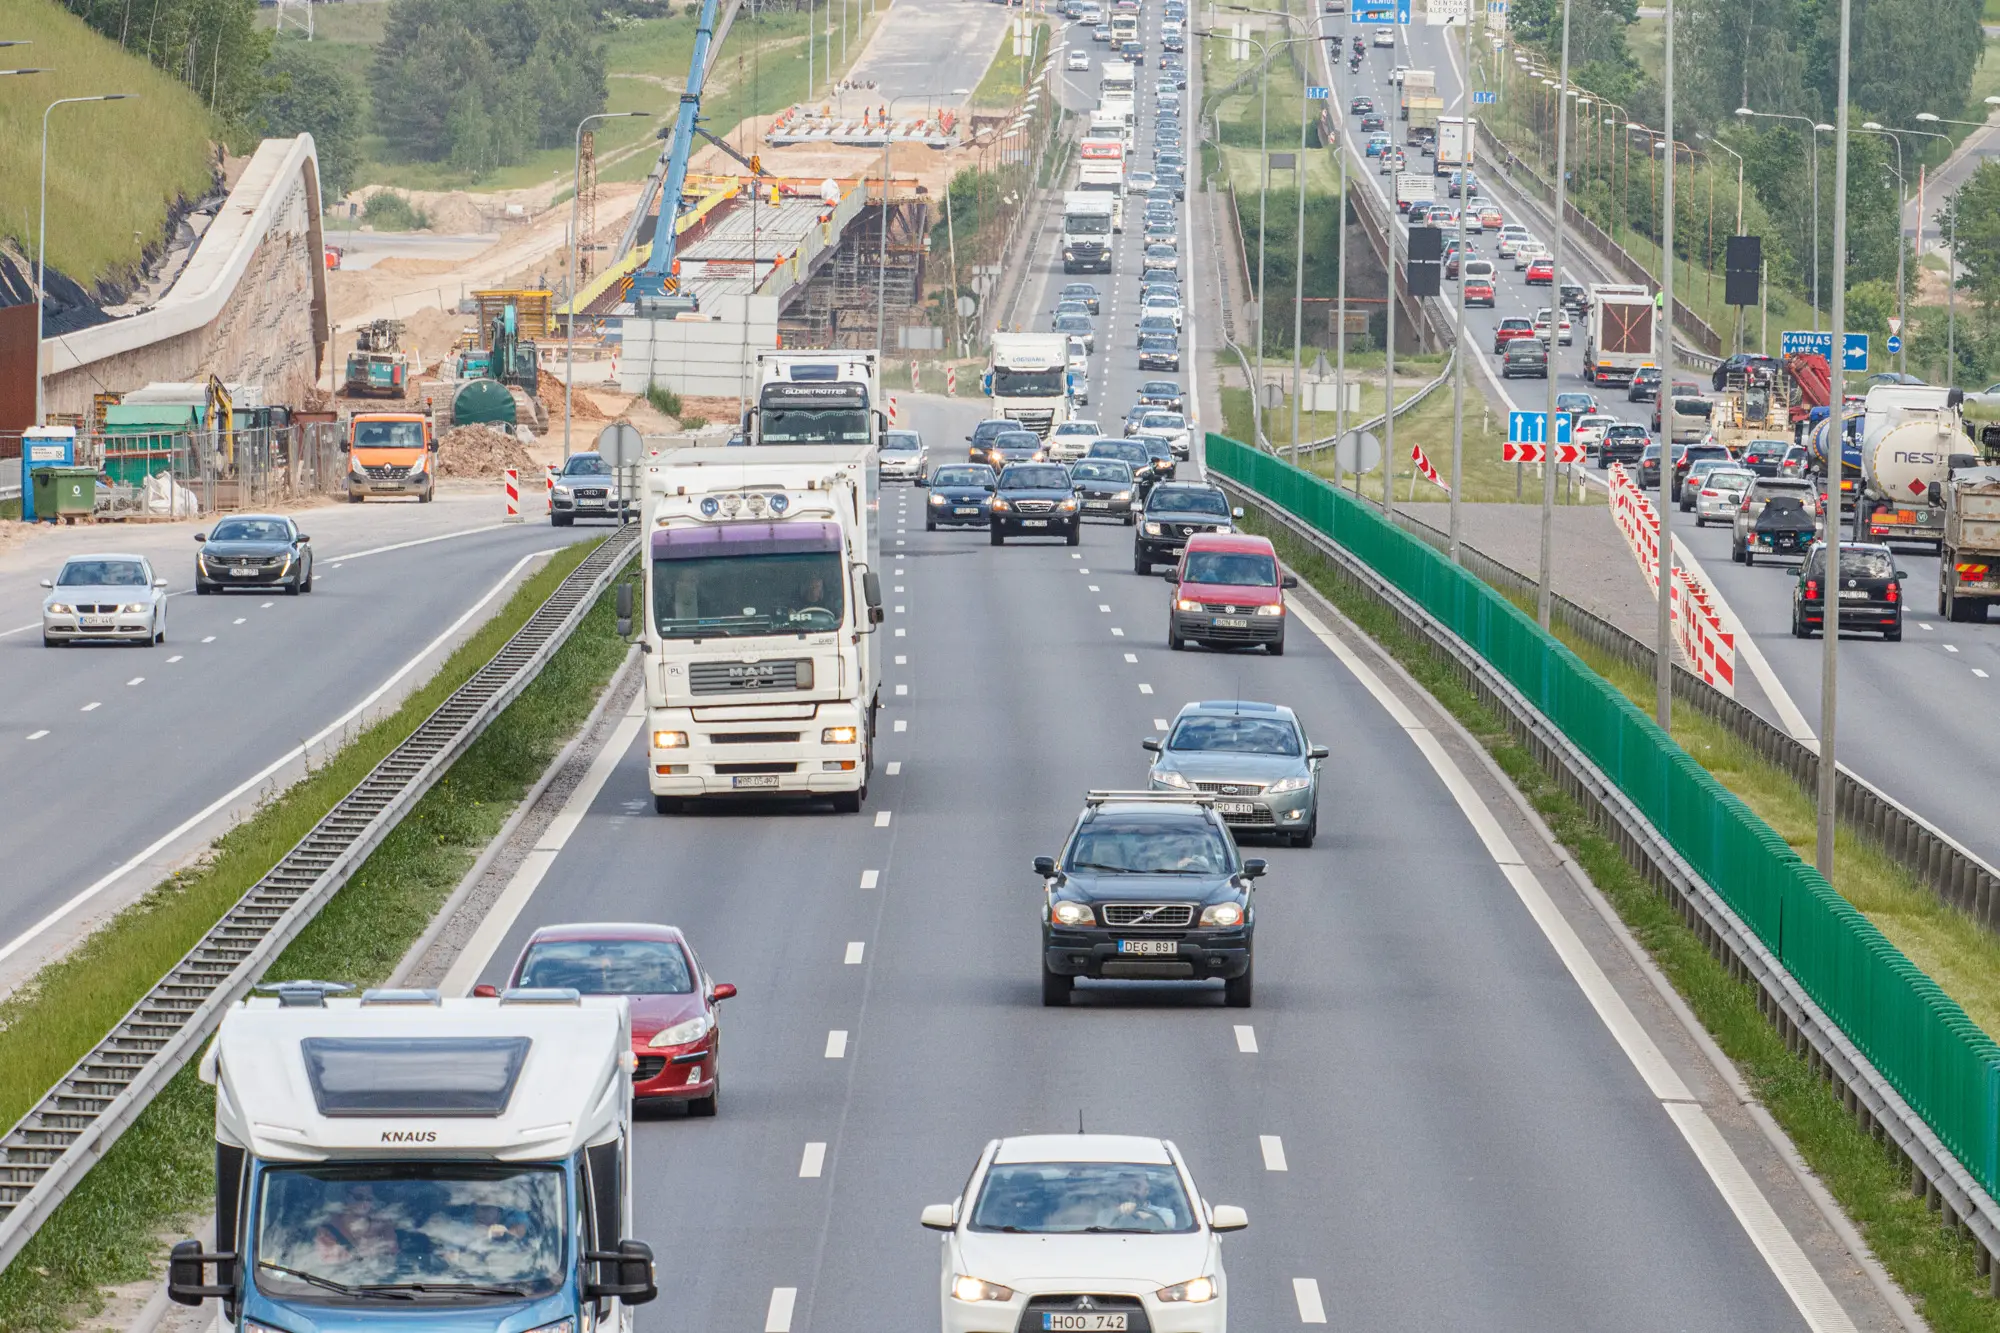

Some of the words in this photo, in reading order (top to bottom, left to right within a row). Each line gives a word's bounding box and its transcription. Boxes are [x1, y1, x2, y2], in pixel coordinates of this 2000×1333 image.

[1783, 335, 1831, 345] KAUNAS
[729, 666, 774, 677] MAN
[1235, 803, 1252, 812] 610
[1125, 941, 1149, 952] DEG
[1155, 942, 1175, 952] 891
[381, 1131, 437, 1142] KNAUS
[1053, 1316, 1086, 1329] HOO
[1096, 1316, 1124, 1329] 742
